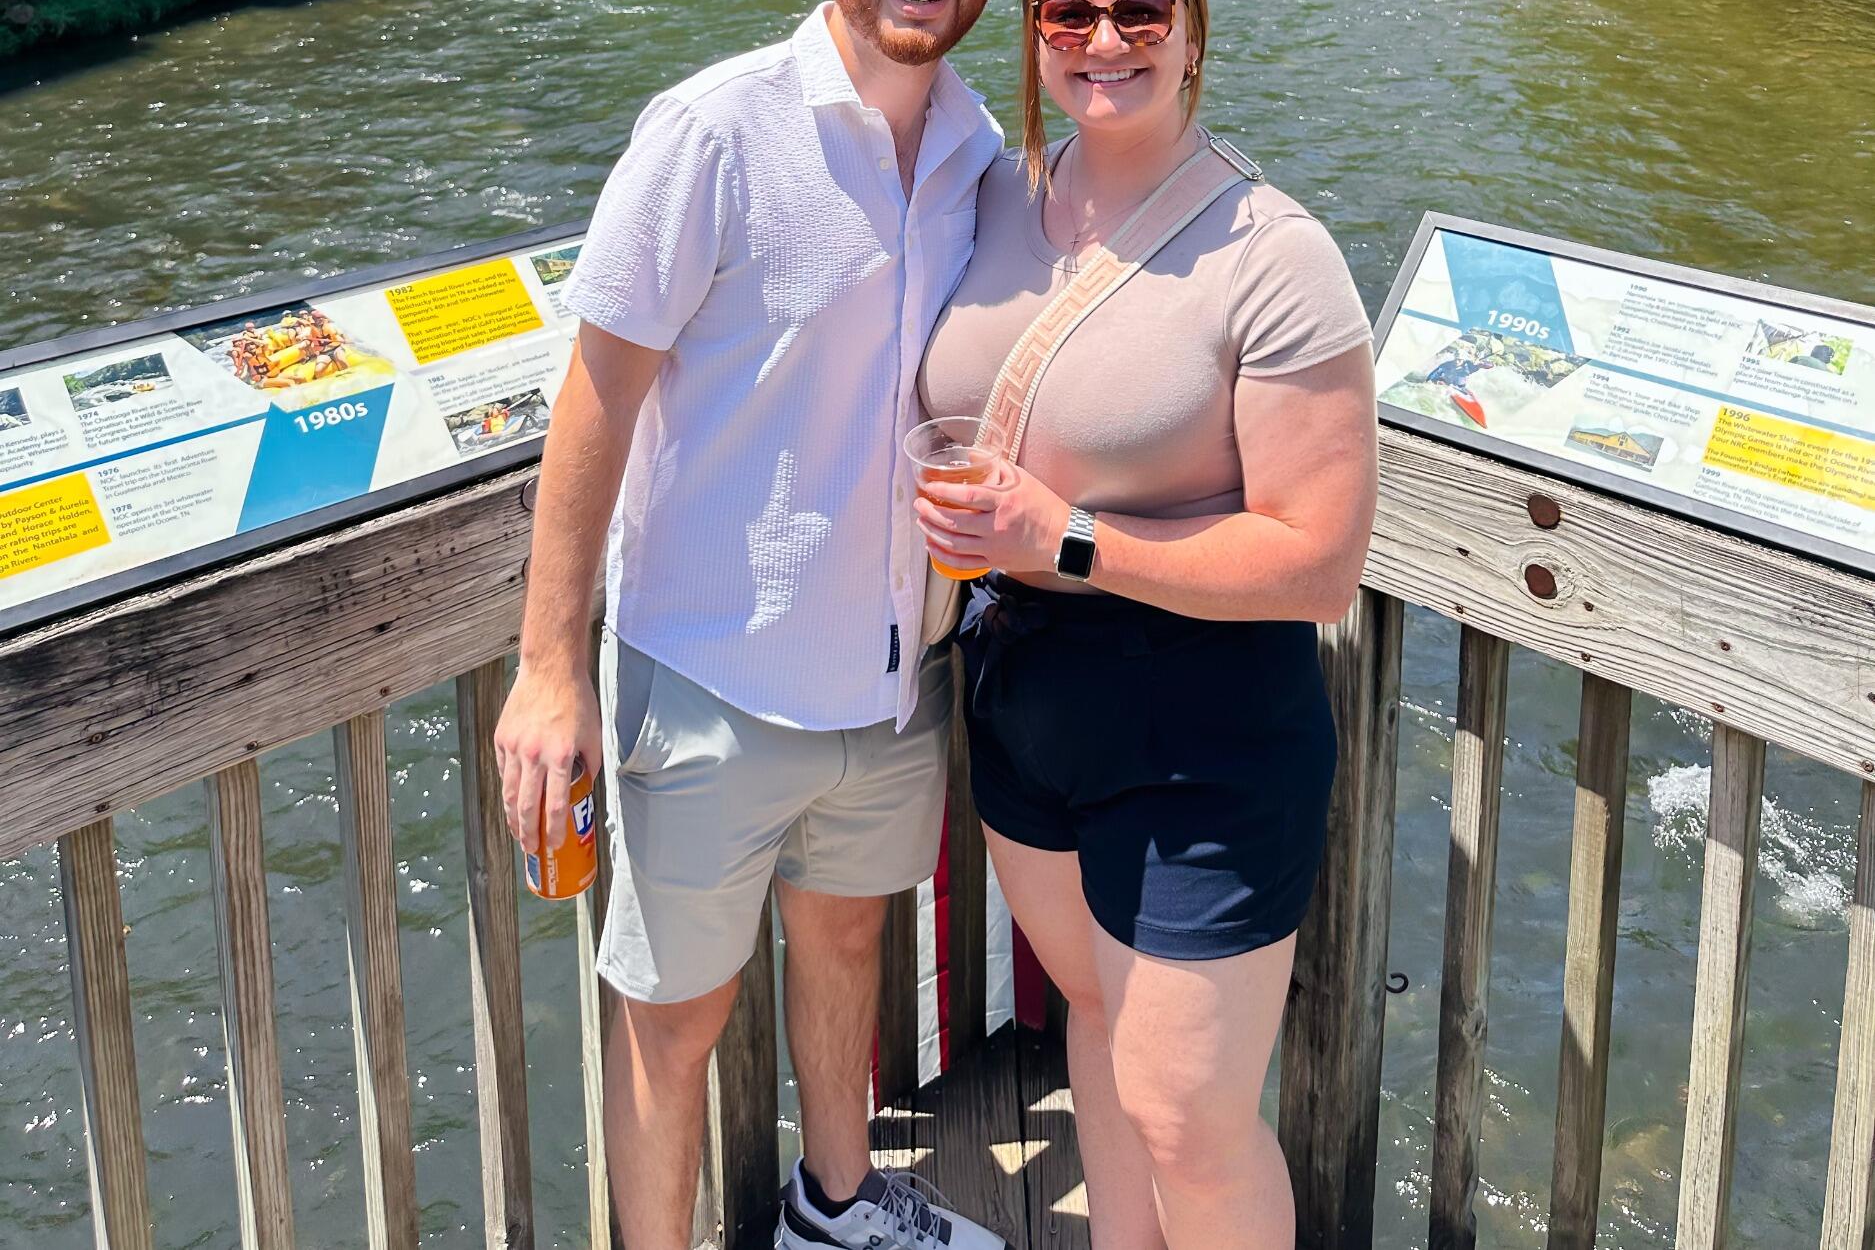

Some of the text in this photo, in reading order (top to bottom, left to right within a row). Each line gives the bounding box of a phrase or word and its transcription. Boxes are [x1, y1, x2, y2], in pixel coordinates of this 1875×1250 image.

[390, 286, 414, 296] 1982
[1488, 310, 1551, 339] 1990s
[79, 411, 99, 420] 1974
[294, 403, 368, 433] 1980s
[1723, 408, 1750, 422] 1996
[1719, 418, 1732, 427] The
[1734, 422, 1777, 438] Whitewater
[1807, 443, 1830, 453] event
[1831, 448, 1843, 457] for
[1845, 452, 1858, 461] the
[98, 467, 119, 477] 1976
[1702, 468, 1721, 477] 1999
[15, 511, 47, 524] Payson
[60, 499, 89, 511] Aurelia
[111, 504, 132, 514] 1978
[1, 529, 17, 539] and
[23, 520, 53, 532] Horace
[10, 535, 39, 546] rafting
[42, 527, 60, 537] trips
[13, 548, 29, 556] the
[33, 533, 77, 550] Nantahala
[83, 525, 99, 535] and
